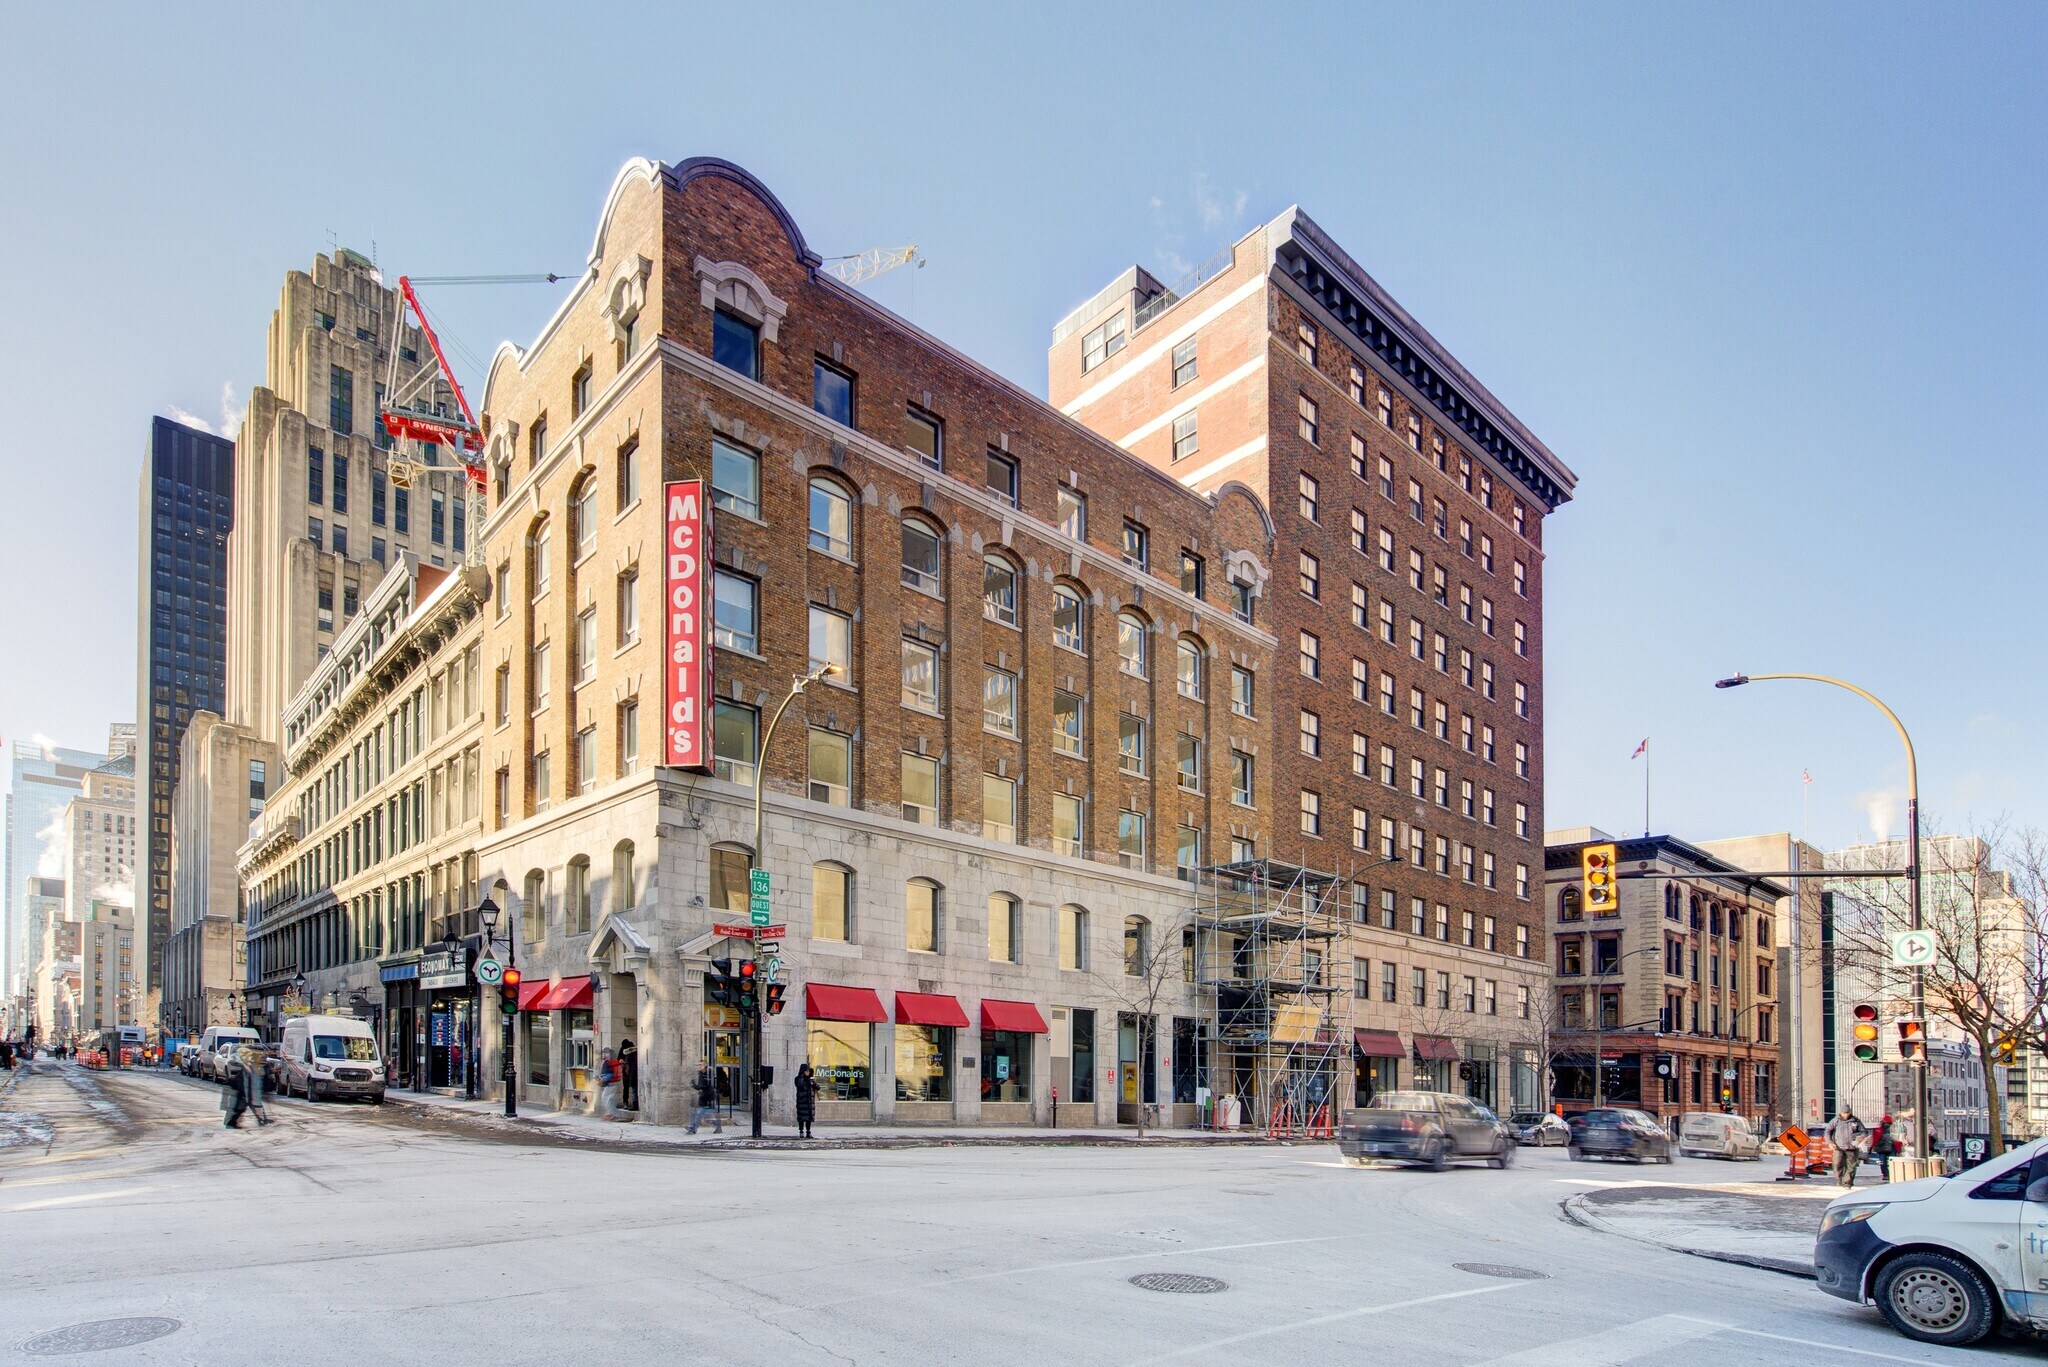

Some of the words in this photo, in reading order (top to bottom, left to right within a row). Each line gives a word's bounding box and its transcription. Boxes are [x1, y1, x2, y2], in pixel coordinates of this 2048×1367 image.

[668, 494, 698, 754] McDonald's
[753, 881, 769, 893] 136
[752, 900, 769, 910] OUEST
[815, 1068, 865, 1079] McDonald's
